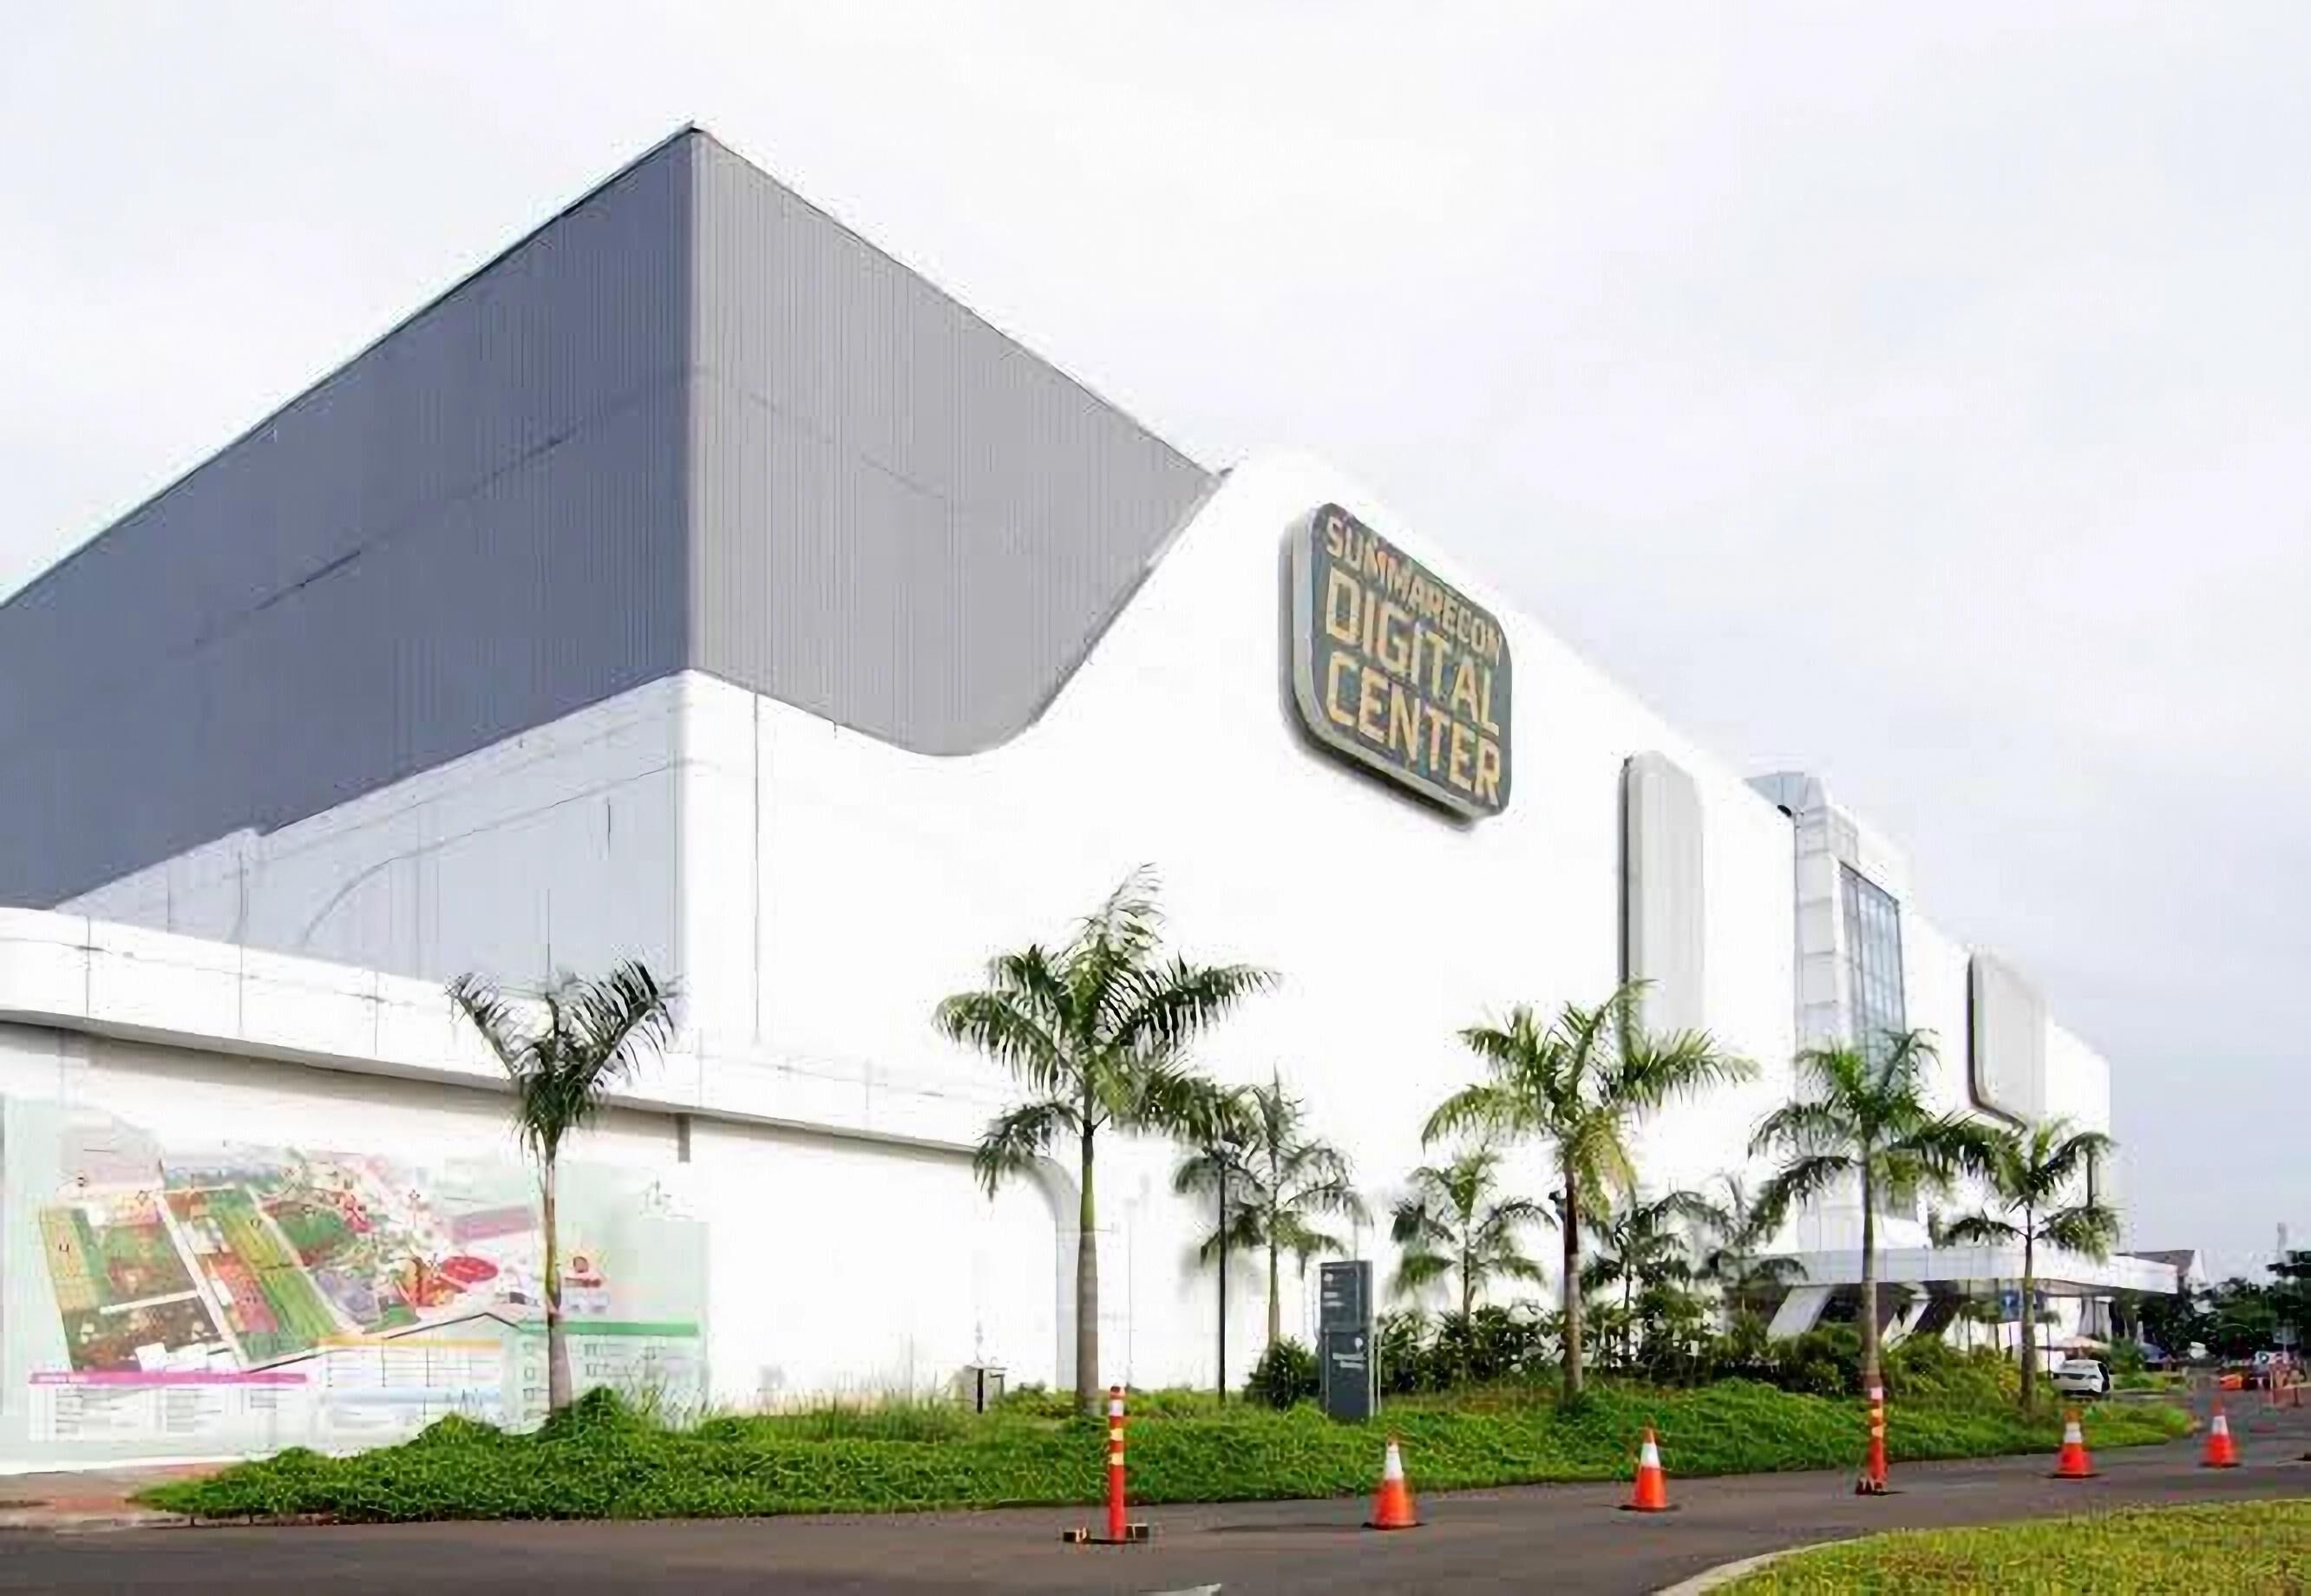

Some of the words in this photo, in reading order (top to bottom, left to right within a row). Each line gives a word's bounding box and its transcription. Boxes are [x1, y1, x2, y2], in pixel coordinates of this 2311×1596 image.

[1326, 516, 1502, 666] SUMMARECON
[1326, 566, 1500, 736] DIGITAL
[1326, 651, 1501, 806] CENTER
